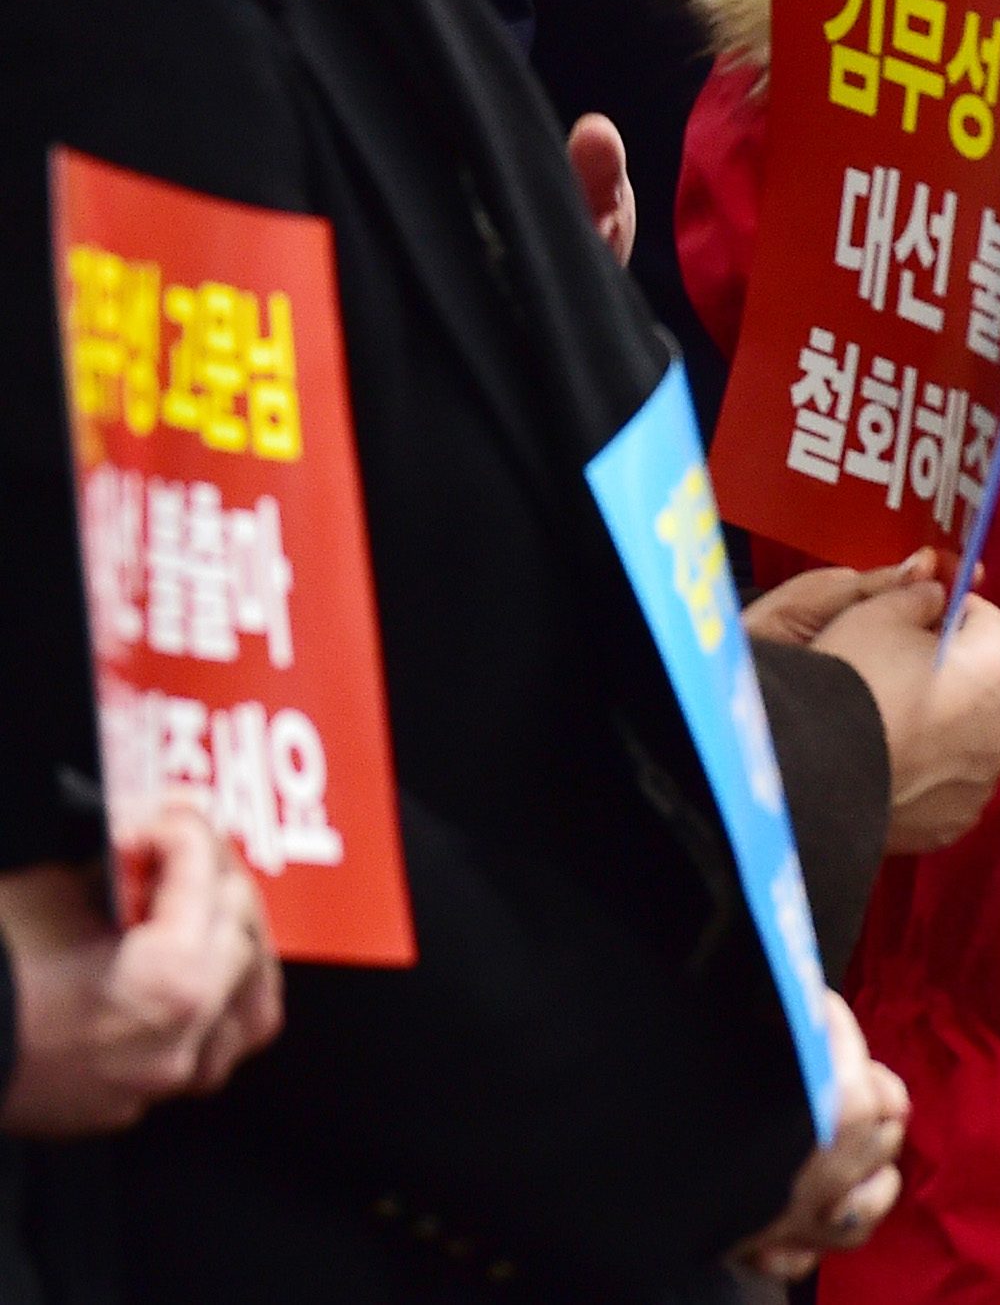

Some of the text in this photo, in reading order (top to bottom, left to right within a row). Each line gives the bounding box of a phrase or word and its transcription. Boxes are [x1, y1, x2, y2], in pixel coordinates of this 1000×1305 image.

[835, 164, 958, 334] 대선
[163, 280, 303, 462] 고문님
[147, 475, 295, 670] 불출마
